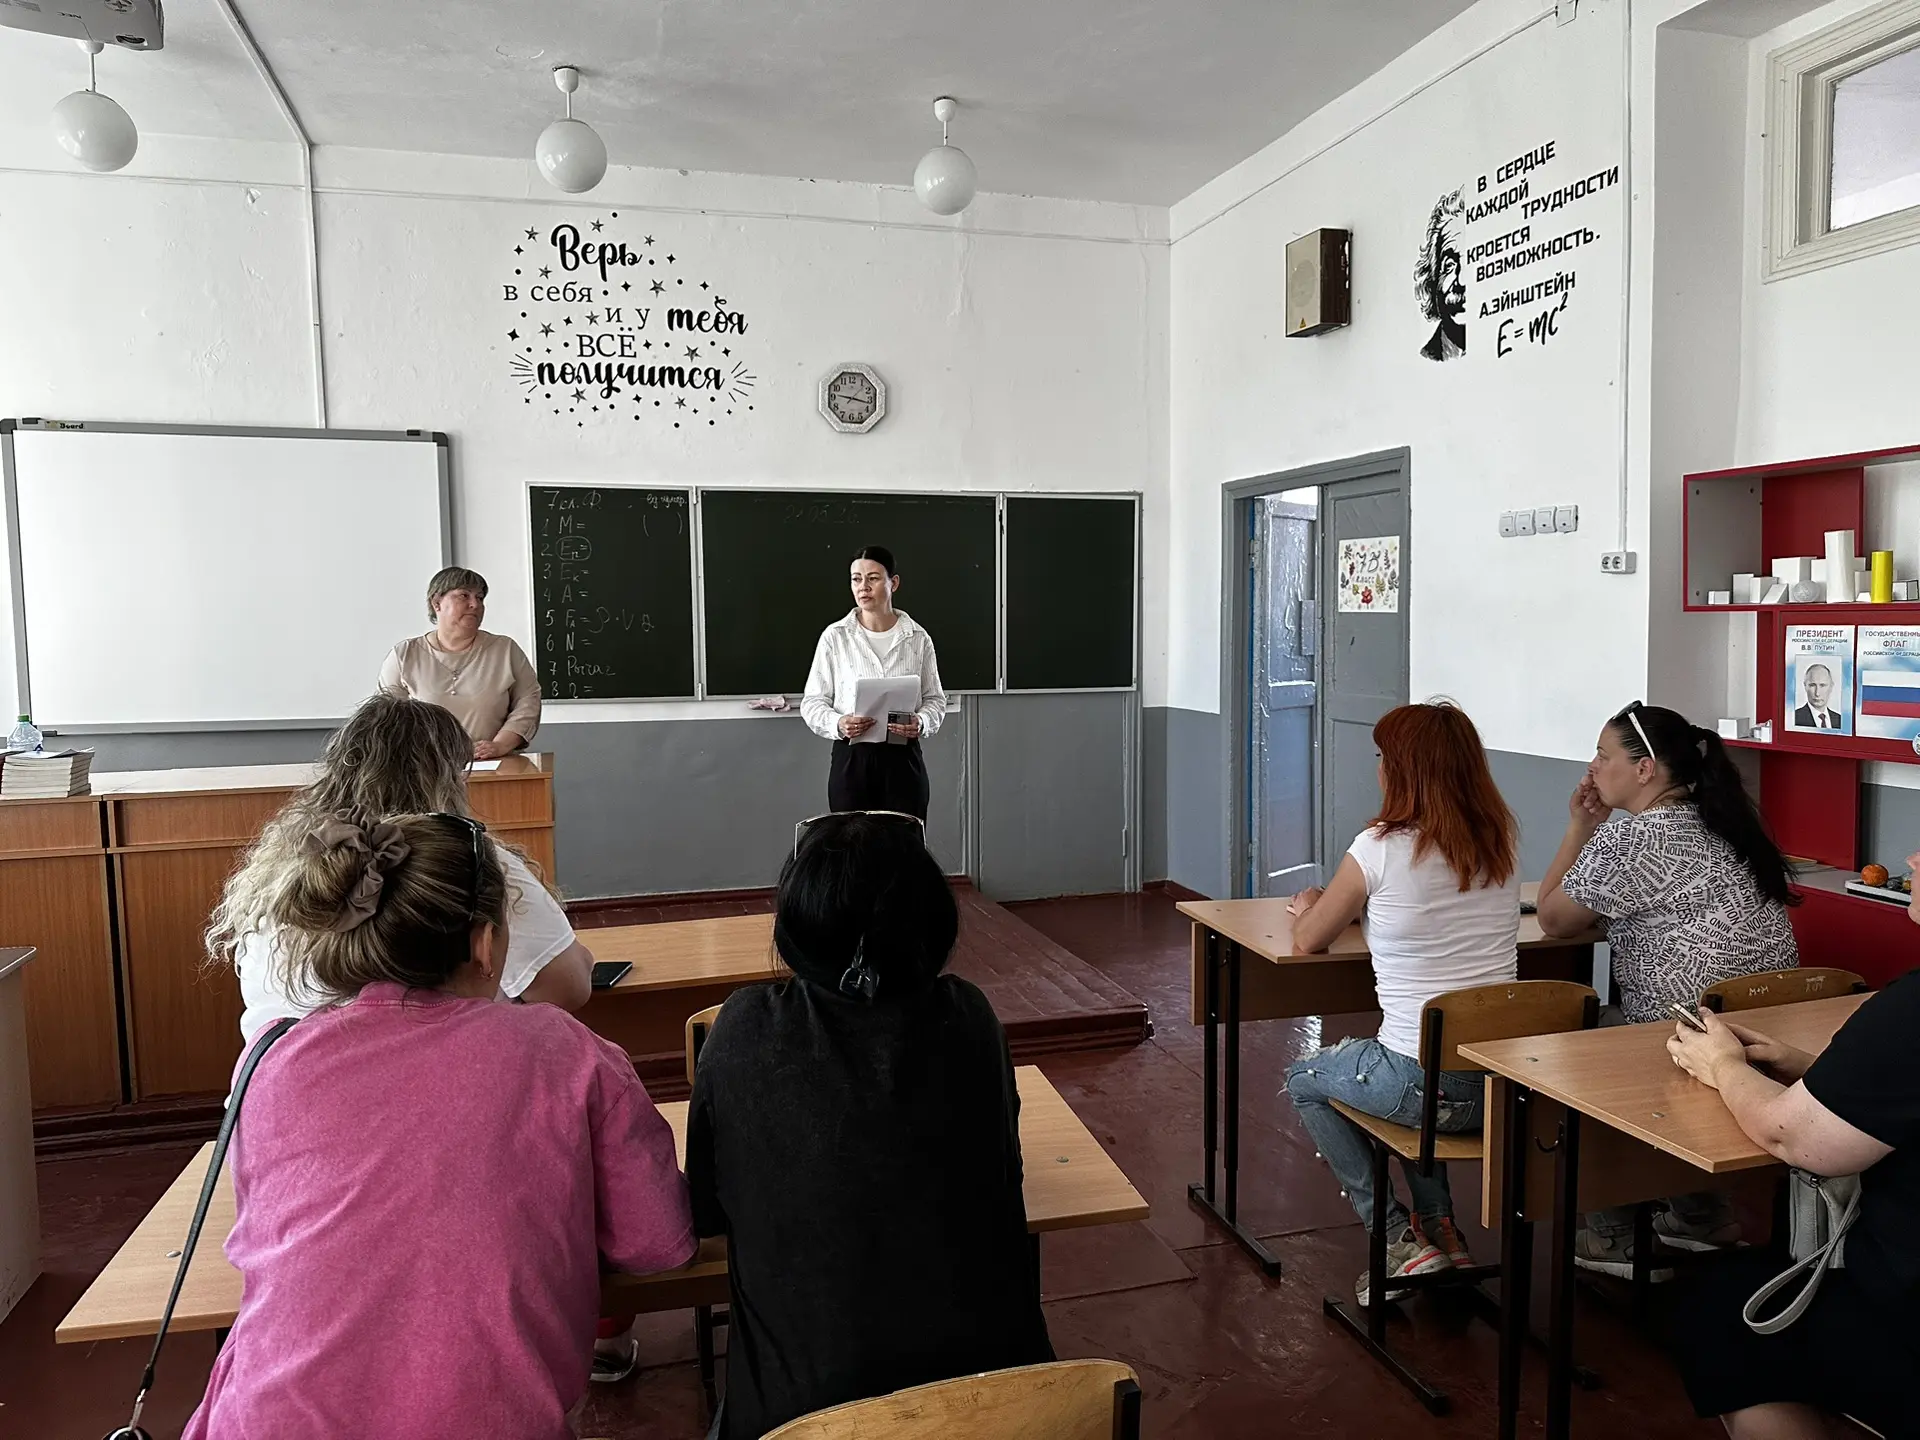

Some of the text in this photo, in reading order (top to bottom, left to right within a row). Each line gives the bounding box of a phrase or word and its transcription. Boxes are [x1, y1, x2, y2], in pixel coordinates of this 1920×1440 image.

[1477, 140, 1556, 194] В СЕРДЦЕ
[1465, 177, 1530, 225] КАЖДОЙ
[1521, 165, 1620, 220] ТРУДНОСТИ
[550, 223, 643, 283] Верь
[1466, 225, 1531, 265] КРОЕТСЯ
[1475, 226, 1602, 283] ВОЗМОЖНОСТЬ.
[502, 280, 594, 303] в себя
[1478, 270, 1577, 319] А.ЭЙНШТЕЙН
[604, 295, 749, 335] и у тебя
[575, 326, 638, 358] ВСЁ
[536, 360, 726, 400] получится
[540, 543, 553, 557] 2
[545, 609, 555, 627] 5
[546, 633, 555, 652] 6
[1795, 630, 1844, 638] ПРЕЗИДЕНТ
[1882, 640, 1908, 648] ФЛАГ
[551, 681, 560, 697] 8
[1709, 917, 1732, 934] MIND
[1688, 944, 1711, 961] IDEA
[1733, 932, 1772, 951] BUSINESS
